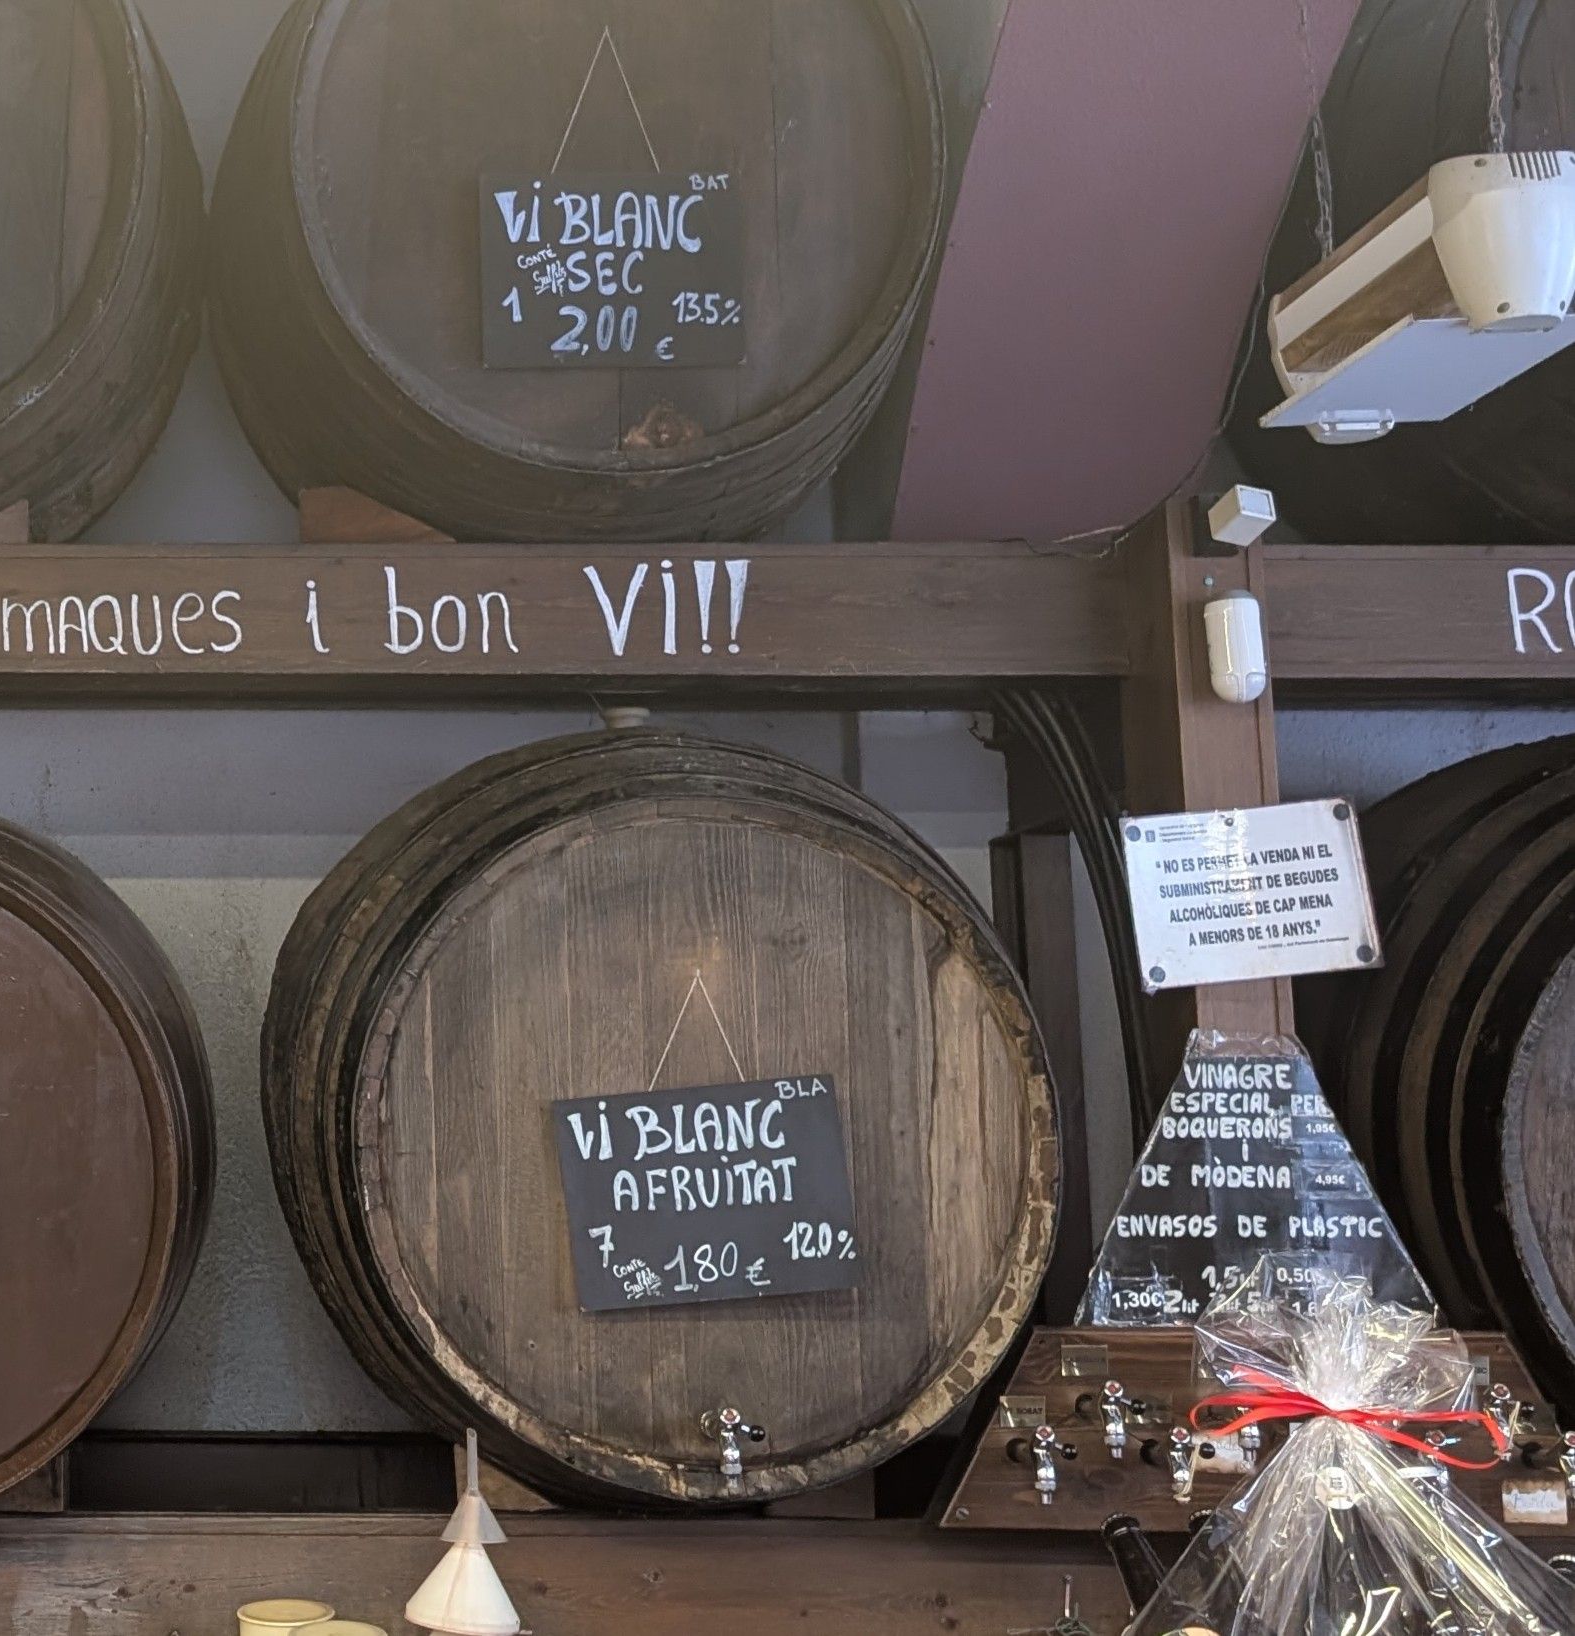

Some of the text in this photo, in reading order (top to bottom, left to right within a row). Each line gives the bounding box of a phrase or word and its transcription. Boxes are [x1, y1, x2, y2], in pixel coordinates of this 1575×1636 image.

[688, 173, 729, 191] BAT
[553, 191, 704, 253] BLANC
[566, 250, 644, 296] SEC
[501, 286, 523, 323] 1
[306, 578, 330, 654] i
[383, 566, 519, 655] bon
[1181, 858, 1194, 872] ES
[1260, 847, 1300, 866] VENDA
[1302, 845, 1315, 859] NI
[1317, 843, 1332, 858] EL
[1266, 874, 1282, 889] DE
[1284, 868, 1339, 887] BEGUDES
[1169, 893, 1333, 923] ALCOHÒLIQUES DE CAP MENA
[1188, 932, 1197, 947] A
[1198, 927, 1245, 945] MENORS
[1247, 925, 1262, 940] DE
[1265, 925, 1279, 939] 18
[773, 1078, 827, 1100] BLA
[1183, 1062, 1293, 1090] VINAGRE
[1170, 1092, 1274, 1115] ESPECIAL
[625, 1098, 785, 1161] BLANC
[1162, 1116, 1292, 1140] BOQUERONS
[1241, 1137, 1249, 1162] i
[1141, 1156, 1291, 1189] DE MÒDENA
[1116, 1215, 1384, 1238] ENVASOS DE PLASTIC
[589, 1223, 614, 1268] 7
